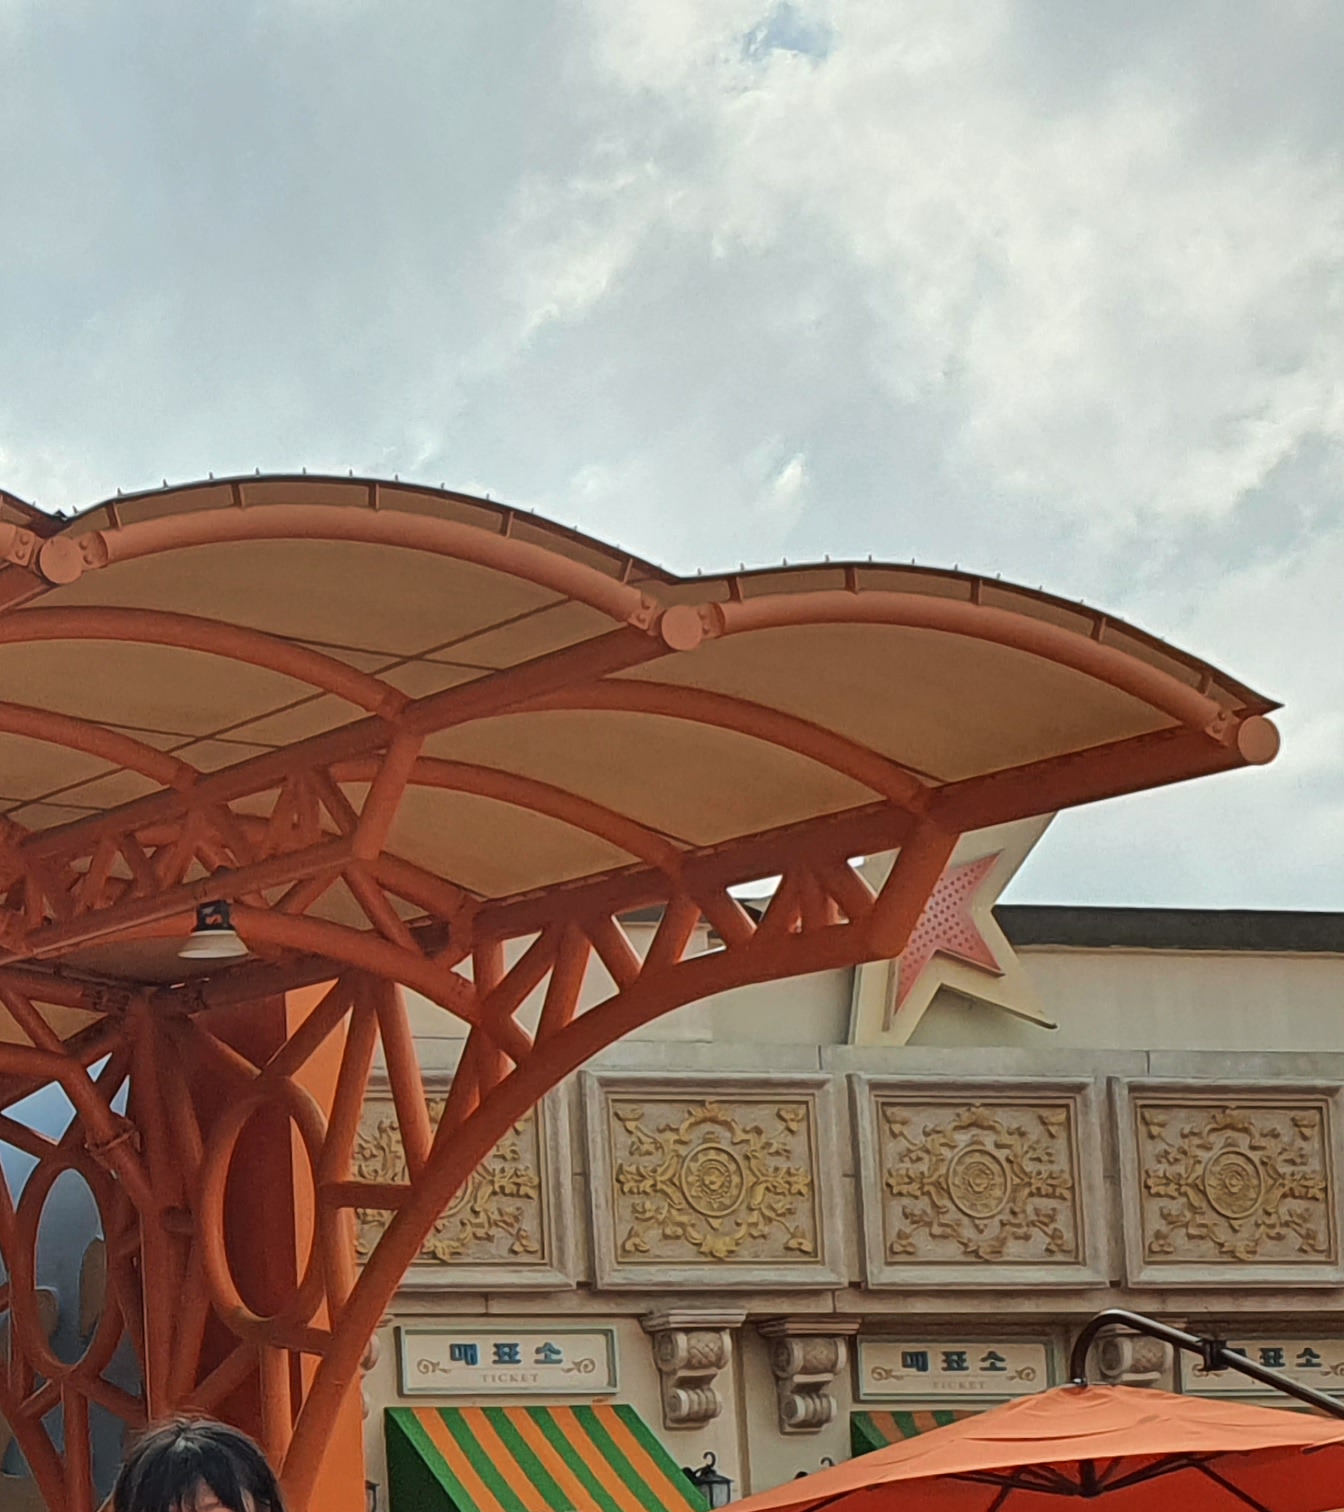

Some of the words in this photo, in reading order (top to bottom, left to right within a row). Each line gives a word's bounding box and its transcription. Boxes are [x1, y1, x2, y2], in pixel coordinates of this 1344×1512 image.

[449, 1341, 564, 1366] 매표소
[901, 1349, 1008, 1373] 매표소
[1227, 1346, 1323, 1369] 표소
[480, 1373, 540, 1384] TICKET
